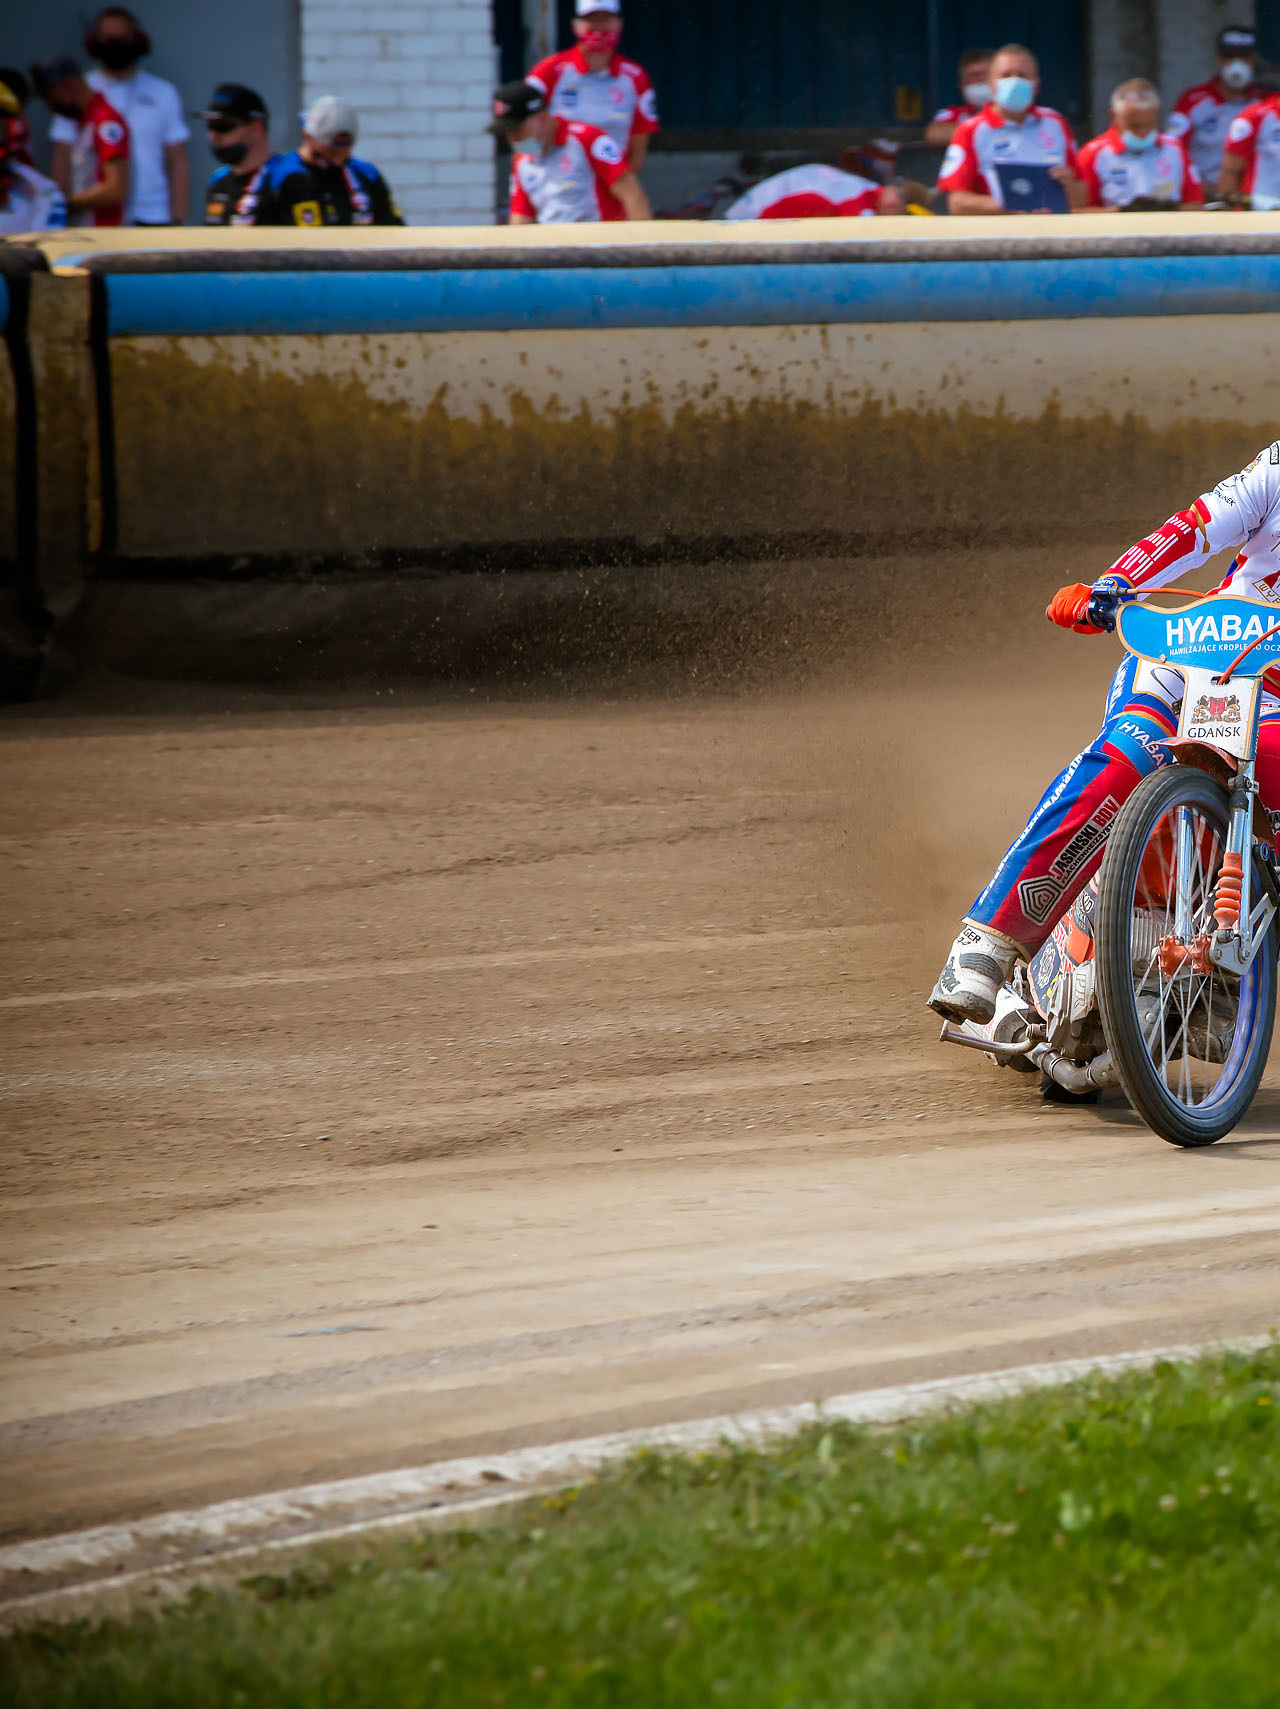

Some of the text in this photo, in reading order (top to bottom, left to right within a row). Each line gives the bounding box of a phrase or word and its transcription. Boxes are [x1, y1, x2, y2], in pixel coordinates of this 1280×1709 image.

[1218, 643, 1248, 651] KROPLE
[1119, 721, 1168, 768] HYABA
[1187, 725, 1241, 739] GDAŃSK
[1051, 823, 1100, 880] JASINSKI
[1091, 798, 1120, 828] BDV
